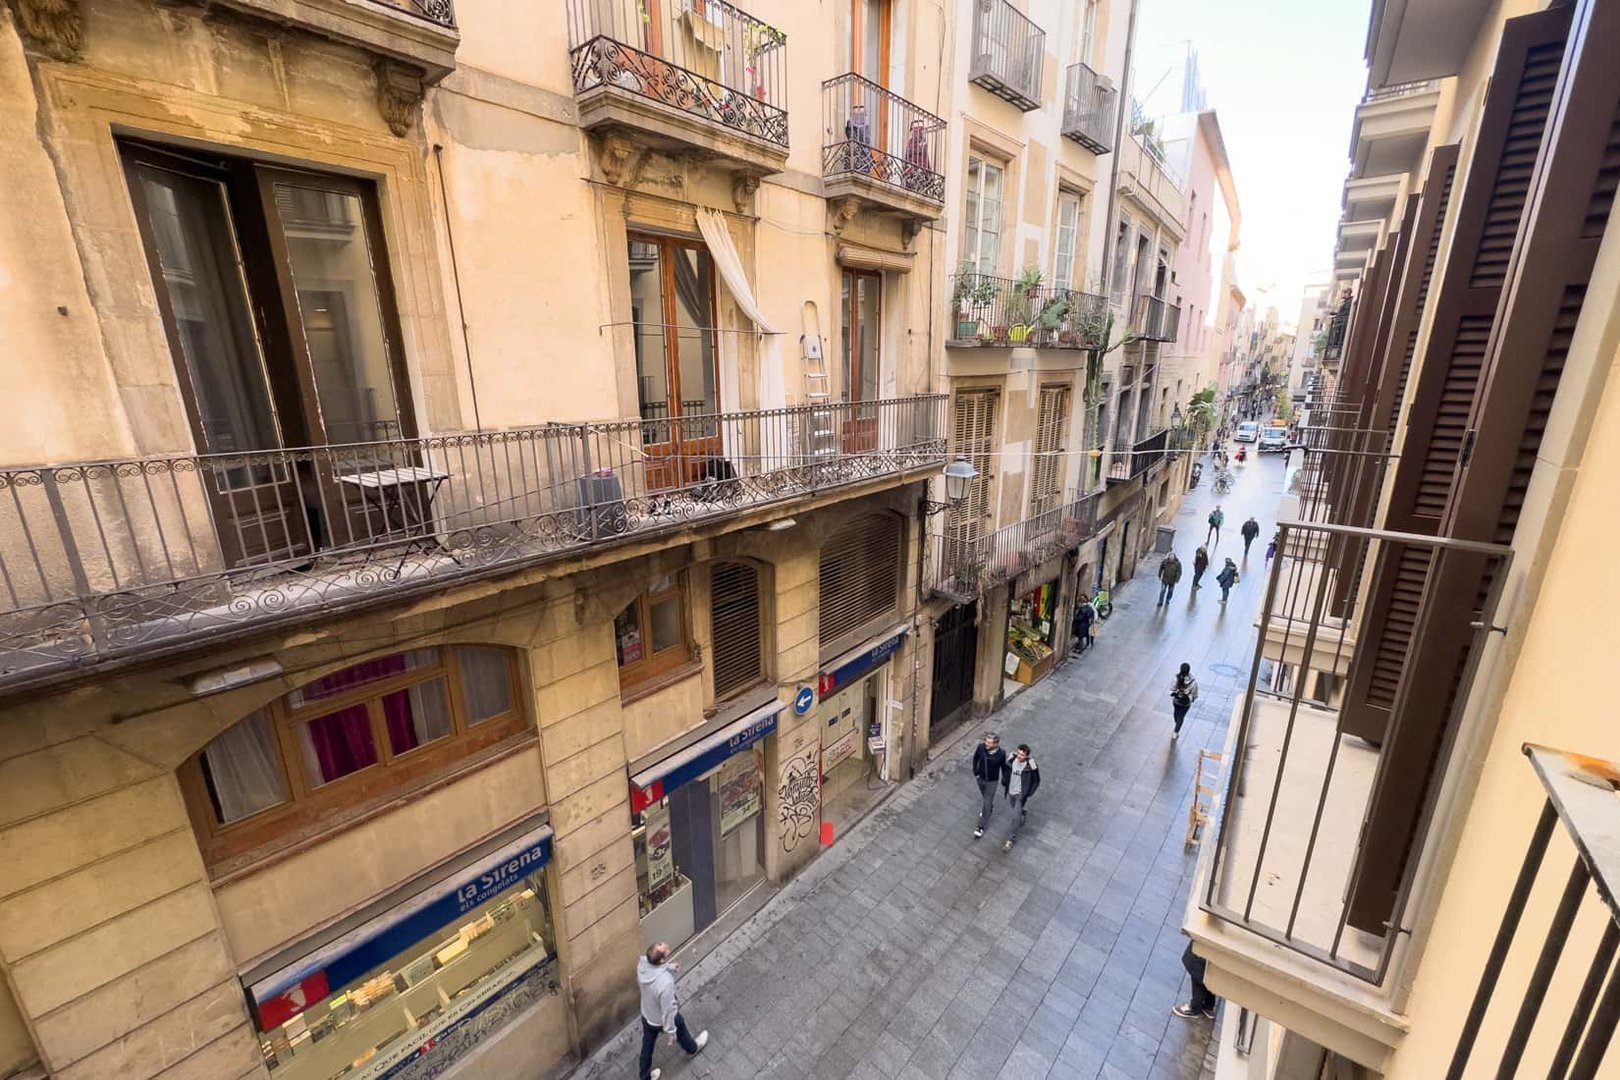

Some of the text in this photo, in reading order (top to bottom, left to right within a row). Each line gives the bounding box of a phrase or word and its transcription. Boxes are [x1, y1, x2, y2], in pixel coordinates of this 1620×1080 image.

[457, 846, 542, 903] La Sirena
[477, 873, 519, 902] congelats
